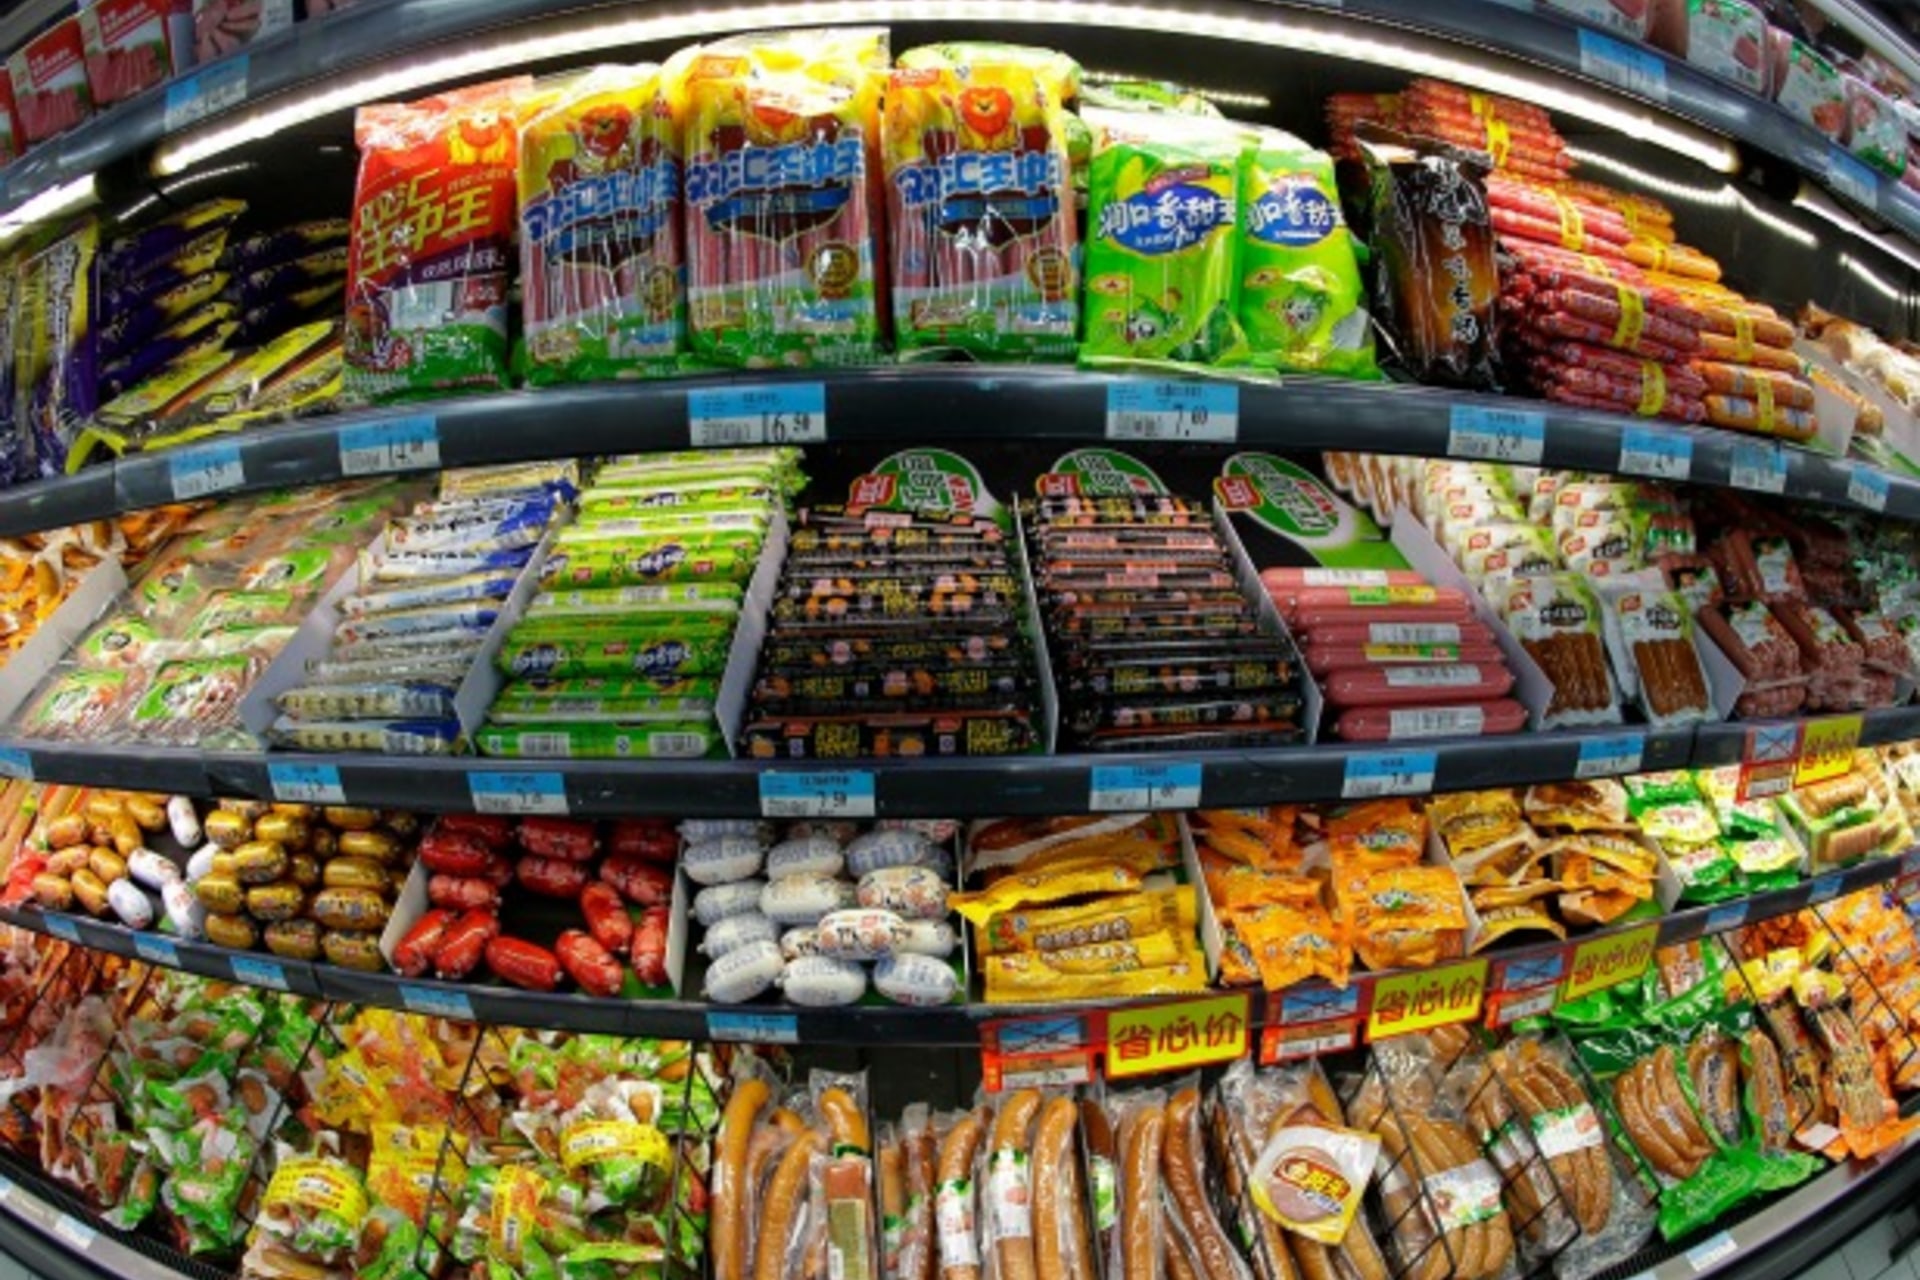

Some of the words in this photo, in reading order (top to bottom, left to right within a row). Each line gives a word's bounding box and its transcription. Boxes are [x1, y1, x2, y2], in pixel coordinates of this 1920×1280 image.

[684, 138, 865, 206] 双汇王中王
[1375, 974, 1479, 1025] 省心价
[1113, 1011, 1242, 1063] 省心价
